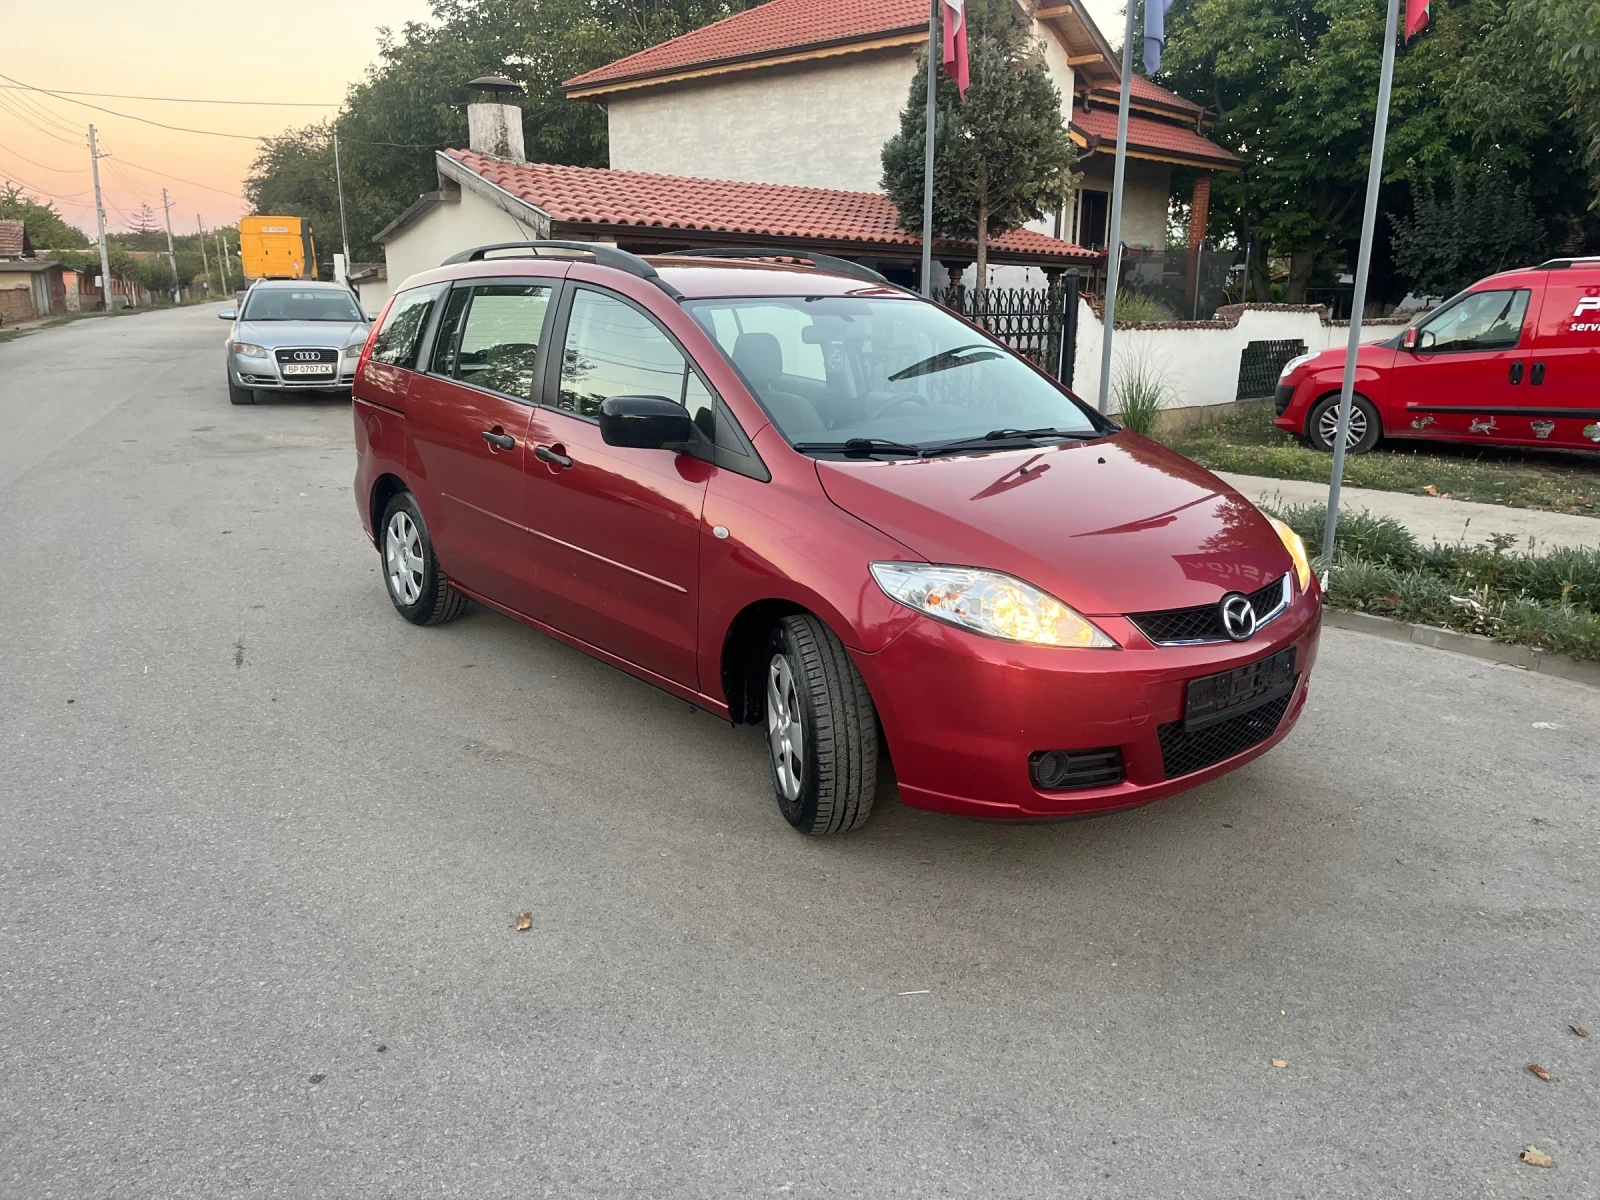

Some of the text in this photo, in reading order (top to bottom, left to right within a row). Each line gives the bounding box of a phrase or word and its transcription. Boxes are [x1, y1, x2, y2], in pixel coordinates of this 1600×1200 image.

[288, 365, 331, 374] BP 0707 CK
